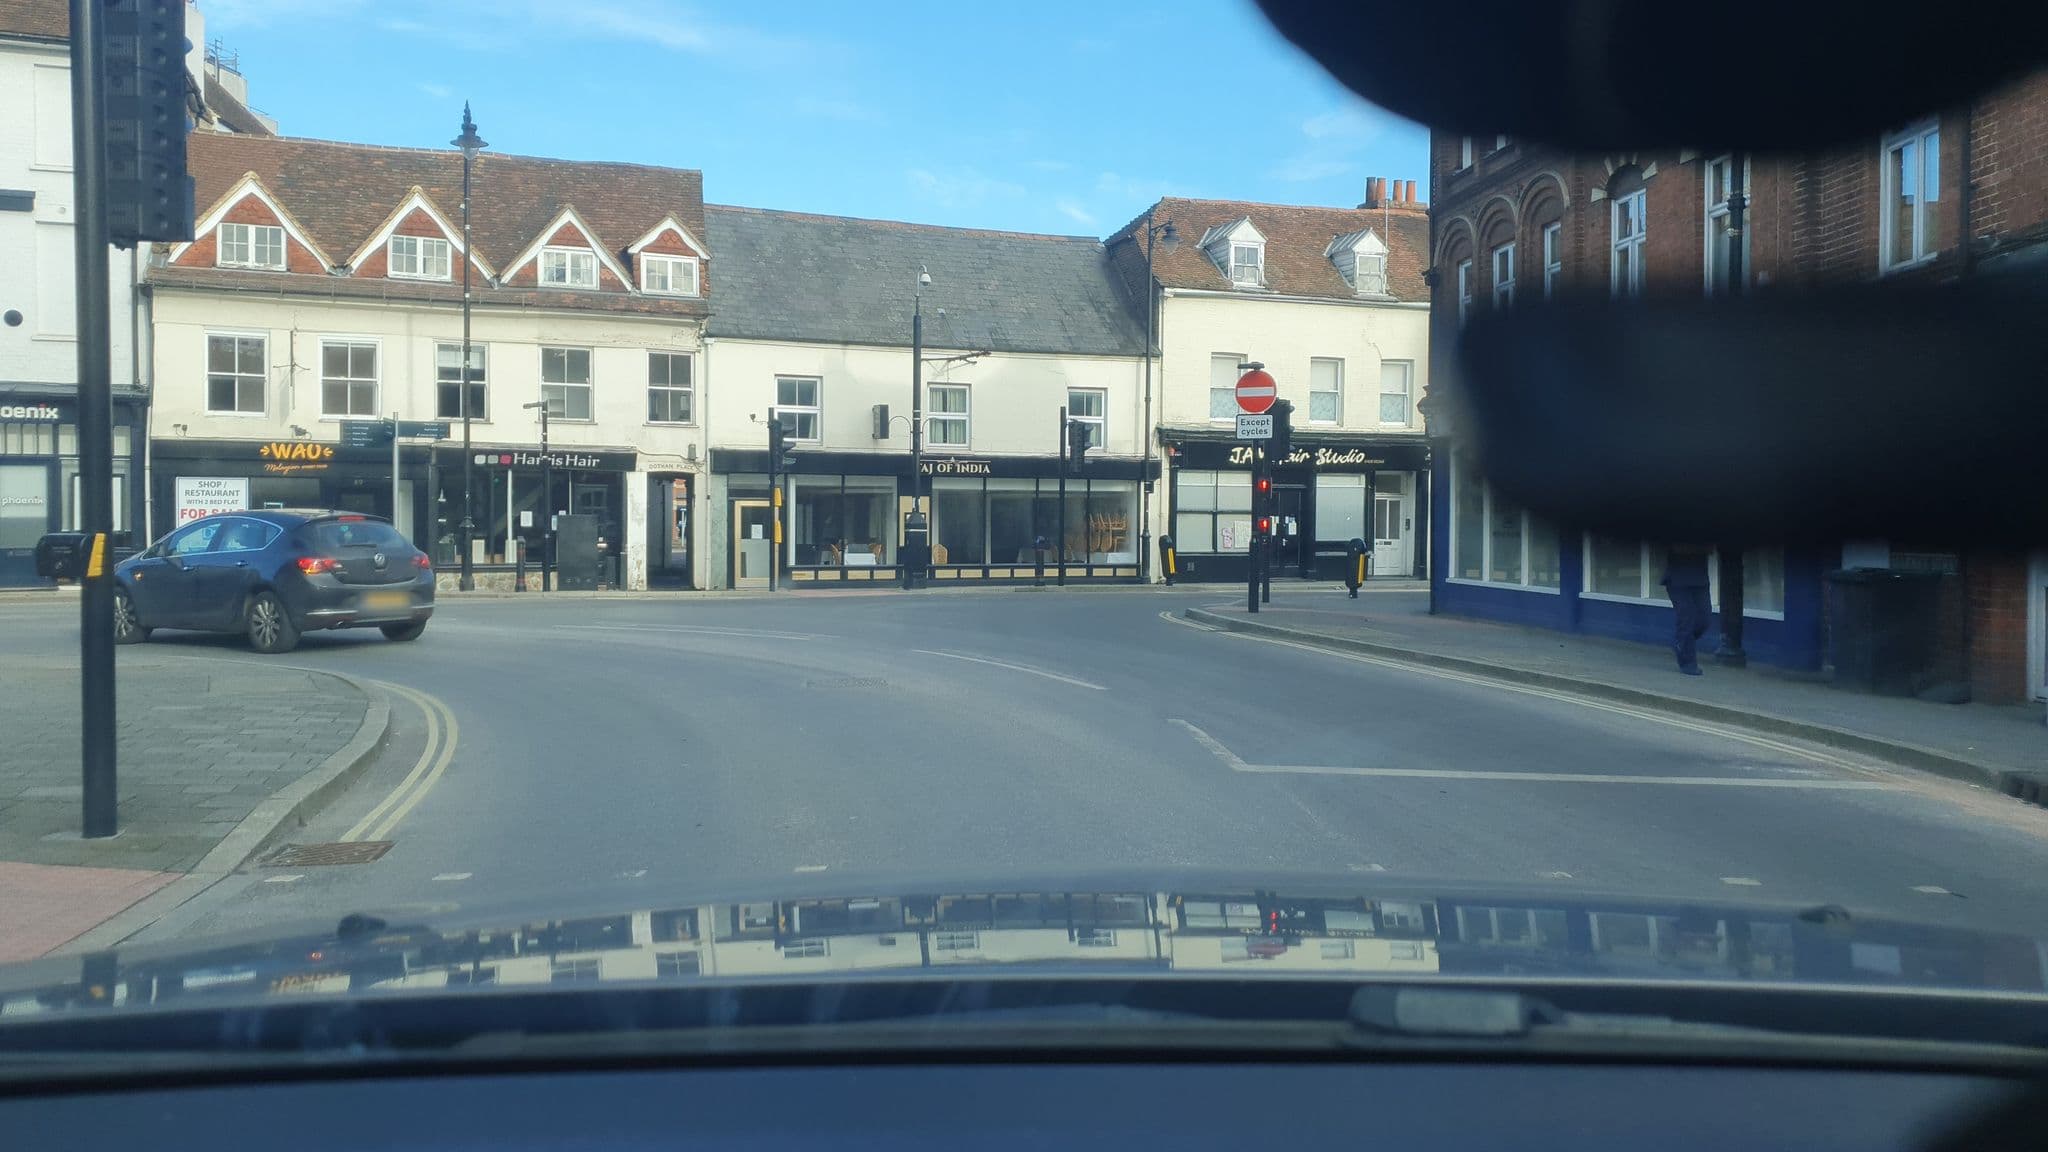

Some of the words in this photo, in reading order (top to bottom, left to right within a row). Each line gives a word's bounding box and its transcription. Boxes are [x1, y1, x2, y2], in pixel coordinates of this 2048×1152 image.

[1240, 418, 1270, 427] Except
[1241, 427, 1268, 436] cycles
[271, 442, 321, 460] WAU
[1316, 447, 1365, 465] Studio
[513, 452, 563, 467] Haris
[565, 454, 600, 467] Hair
[920, 463, 934, 475] AJ
[937, 463, 953, 473] OF
[956, 463, 991, 474] INDIA
[198, 480, 222, 489] SHOP
[184, 489, 241, 497] RESTAURANT
[180, 508, 207, 519] FOR
